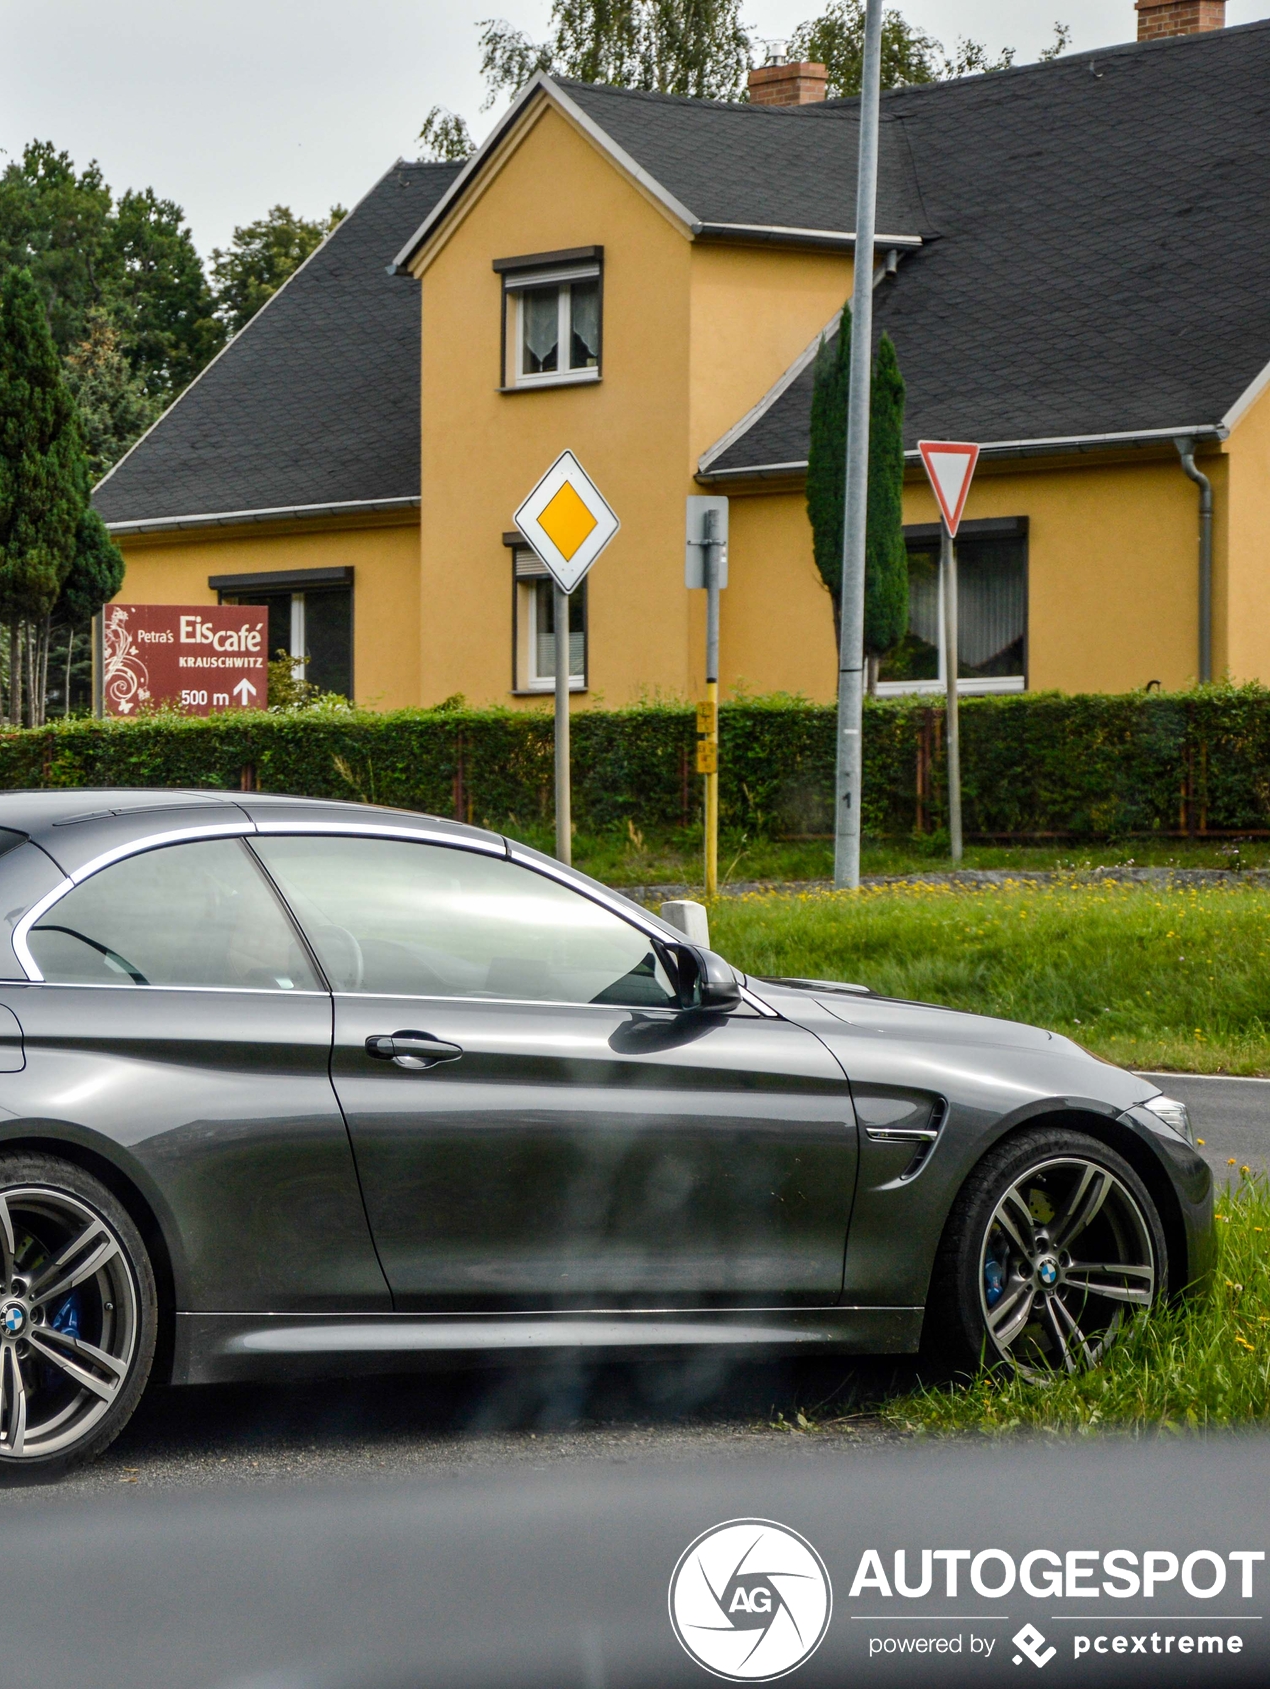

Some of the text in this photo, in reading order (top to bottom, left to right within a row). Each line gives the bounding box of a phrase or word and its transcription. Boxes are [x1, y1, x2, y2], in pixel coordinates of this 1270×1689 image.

[179, 656, 263, 668] KRAUSCHWITZ
[181, 690, 229, 705] 500 m
[842, 792, 852, 809] 1
